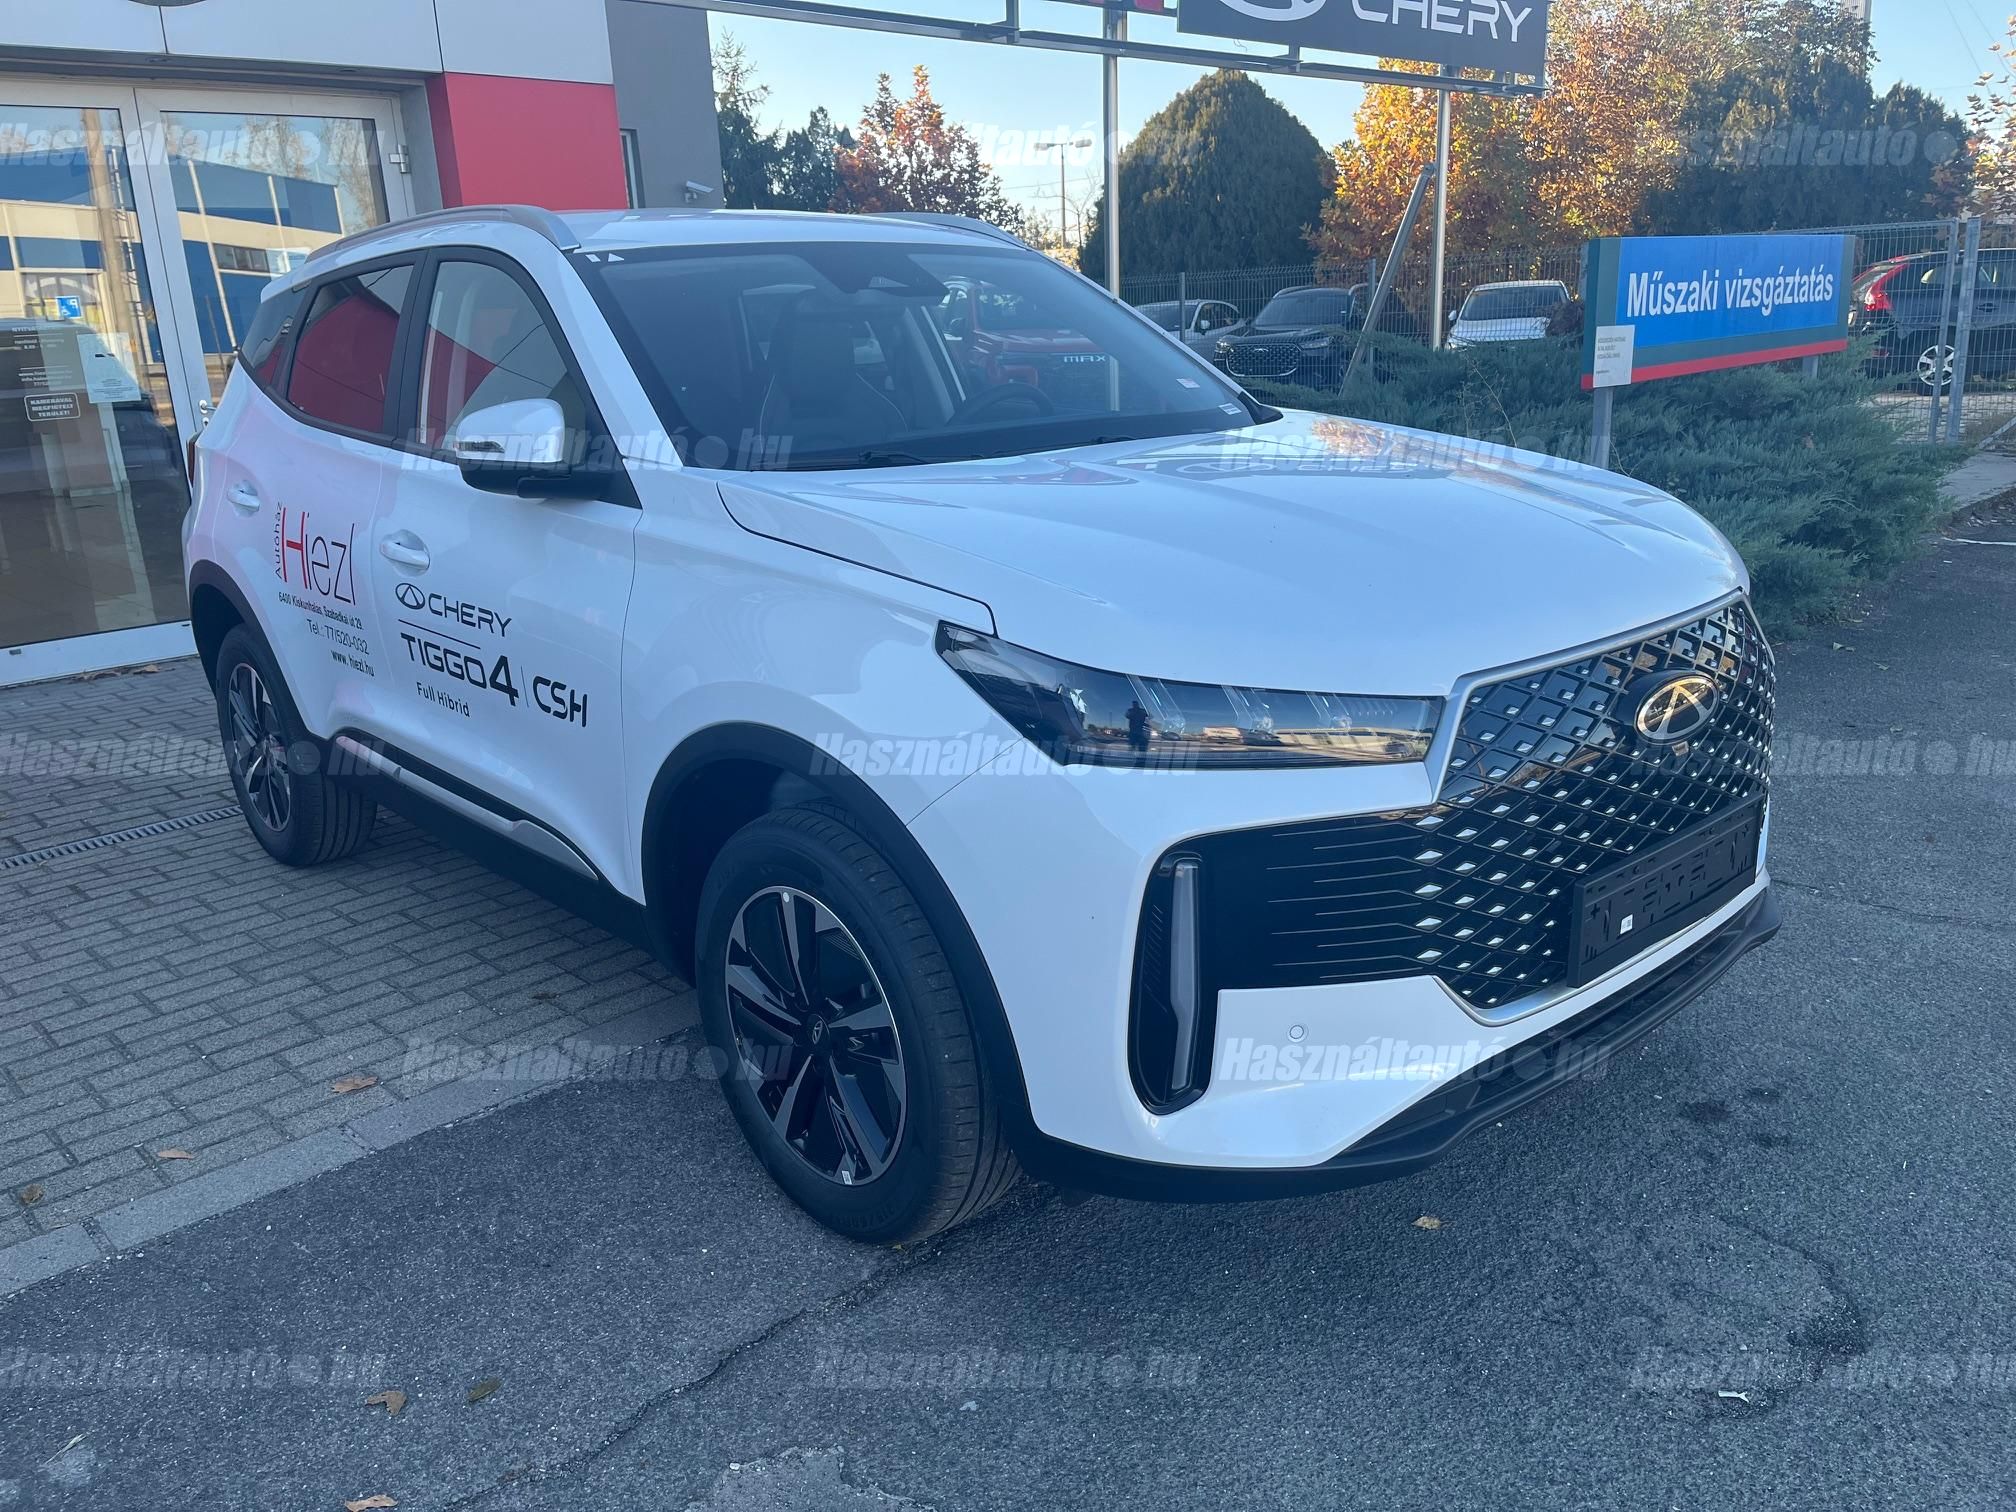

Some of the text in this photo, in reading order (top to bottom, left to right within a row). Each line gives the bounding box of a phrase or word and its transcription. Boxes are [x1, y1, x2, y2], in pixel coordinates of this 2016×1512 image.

[1352, 0, 1533, 43] CHERY
[1626, 264, 1834, 318] Műszaki vizsgáztatás
[281, 507, 357, 606] Hiezl
[428, 592, 513, 638] CHERY
[416, 681, 471, 718] Full Hibrid
[532, 675, 588, 728] CSH
